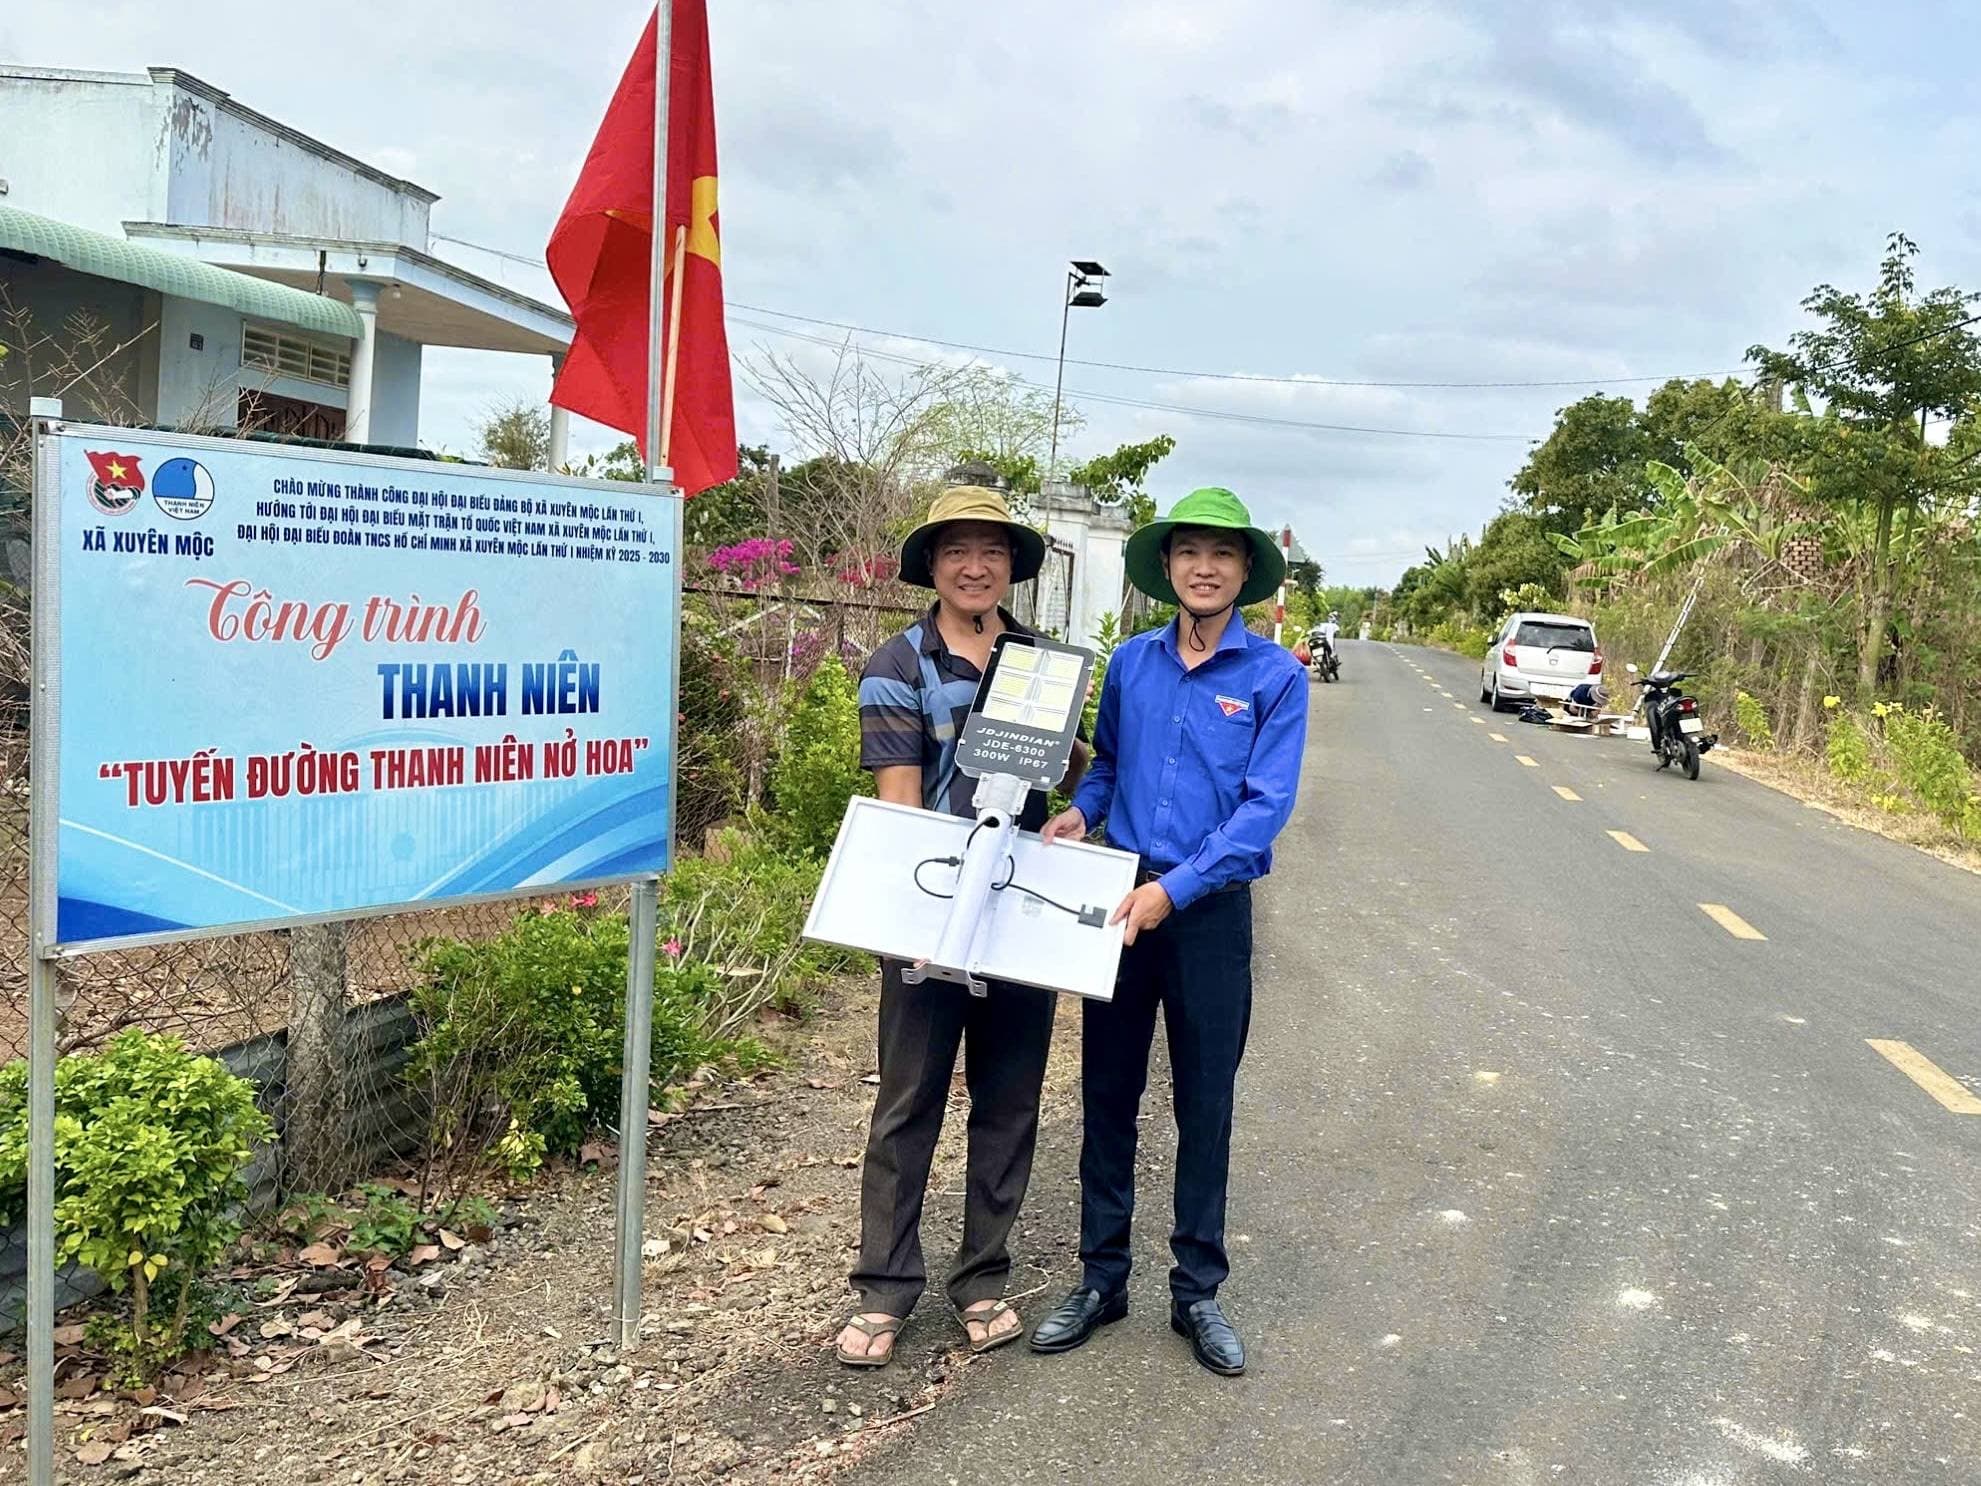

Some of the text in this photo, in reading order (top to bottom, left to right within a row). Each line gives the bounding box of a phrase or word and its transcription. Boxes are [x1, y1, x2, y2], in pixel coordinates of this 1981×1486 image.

[256, 499, 296, 518] HƯỚNG
[300, 501, 316, 520] TỚI
[320, 506, 338, 524] ĐẠI
[341, 505, 359, 525] HỘI
[362, 509, 379, 527] ĐẠI
[408, 510, 431, 530] MẶT
[433, 513, 458, 532] TRẬN
[476, 516, 500, 533] QUỐC
[503, 518, 522, 536] VIỆT
[525, 521, 545, 536] NAM
[548, 521, 560, 537] XÃ
[563, 523, 589, 539] XUYÊN
[592, 525, 612, 543] MỘC
[632, 528, 647, 543] THỨ
[273, 477, 304, 496] CHÀO
[307, 479, 341, 499] MỪNG
[345, 483, 379, 501] THÀNH
[382, 485, 409, 504] CÔNG
[412, 491, 429, 508] ĐẠI
[431, 490, 448, 510] HỘI
[450, 494, 467, 511] ĐẠI
[493, 494, 518, 513] ĐẢNG
[521, 498, 533, 517] BỘ
[535, 499, 547, 515] XÃ
[550, 501, 577, 518] XUYÊN
[580, 504, 600, 522] MỘC
[620, 507, 636, 523] THỨ
[82, 525, 214, 561] XÃ XUYÊN MỘC
[237, 524, 257, 543] ĐẠI
[260, 523, 280, 544] HỘI
[283, 527, 302, 545] ĐẠI
[333, 527, 361, 546] ĐOÀN
[365, 532, 391, 548] TNCS
[411, 533, 427, 549] CHÍ
[430, 536, 457, 551] MINH
[460, 536, 472, 553] XÃ
[475, 537, 505, 554] XUYÊN
[507, 539, 529, 558] MỘC
[551, 542, 568, 558] THỨ
[576, 544, 603, 562] NHIỆM
[619, 549, 641, 563] 2025
[649, 551, 670, 564] 2030
[184, 578, 488, 661] Công trình
[377, 649, 600, 720] THANH NIÊN
[98, 728, 650, 807] “TUYẾN ĐƯỜNG THANH NIÊN NỞ HOA”
[973, 748, 1049, 769] 300W IP67
[982, 739, 1046, 757] JDE-6300
